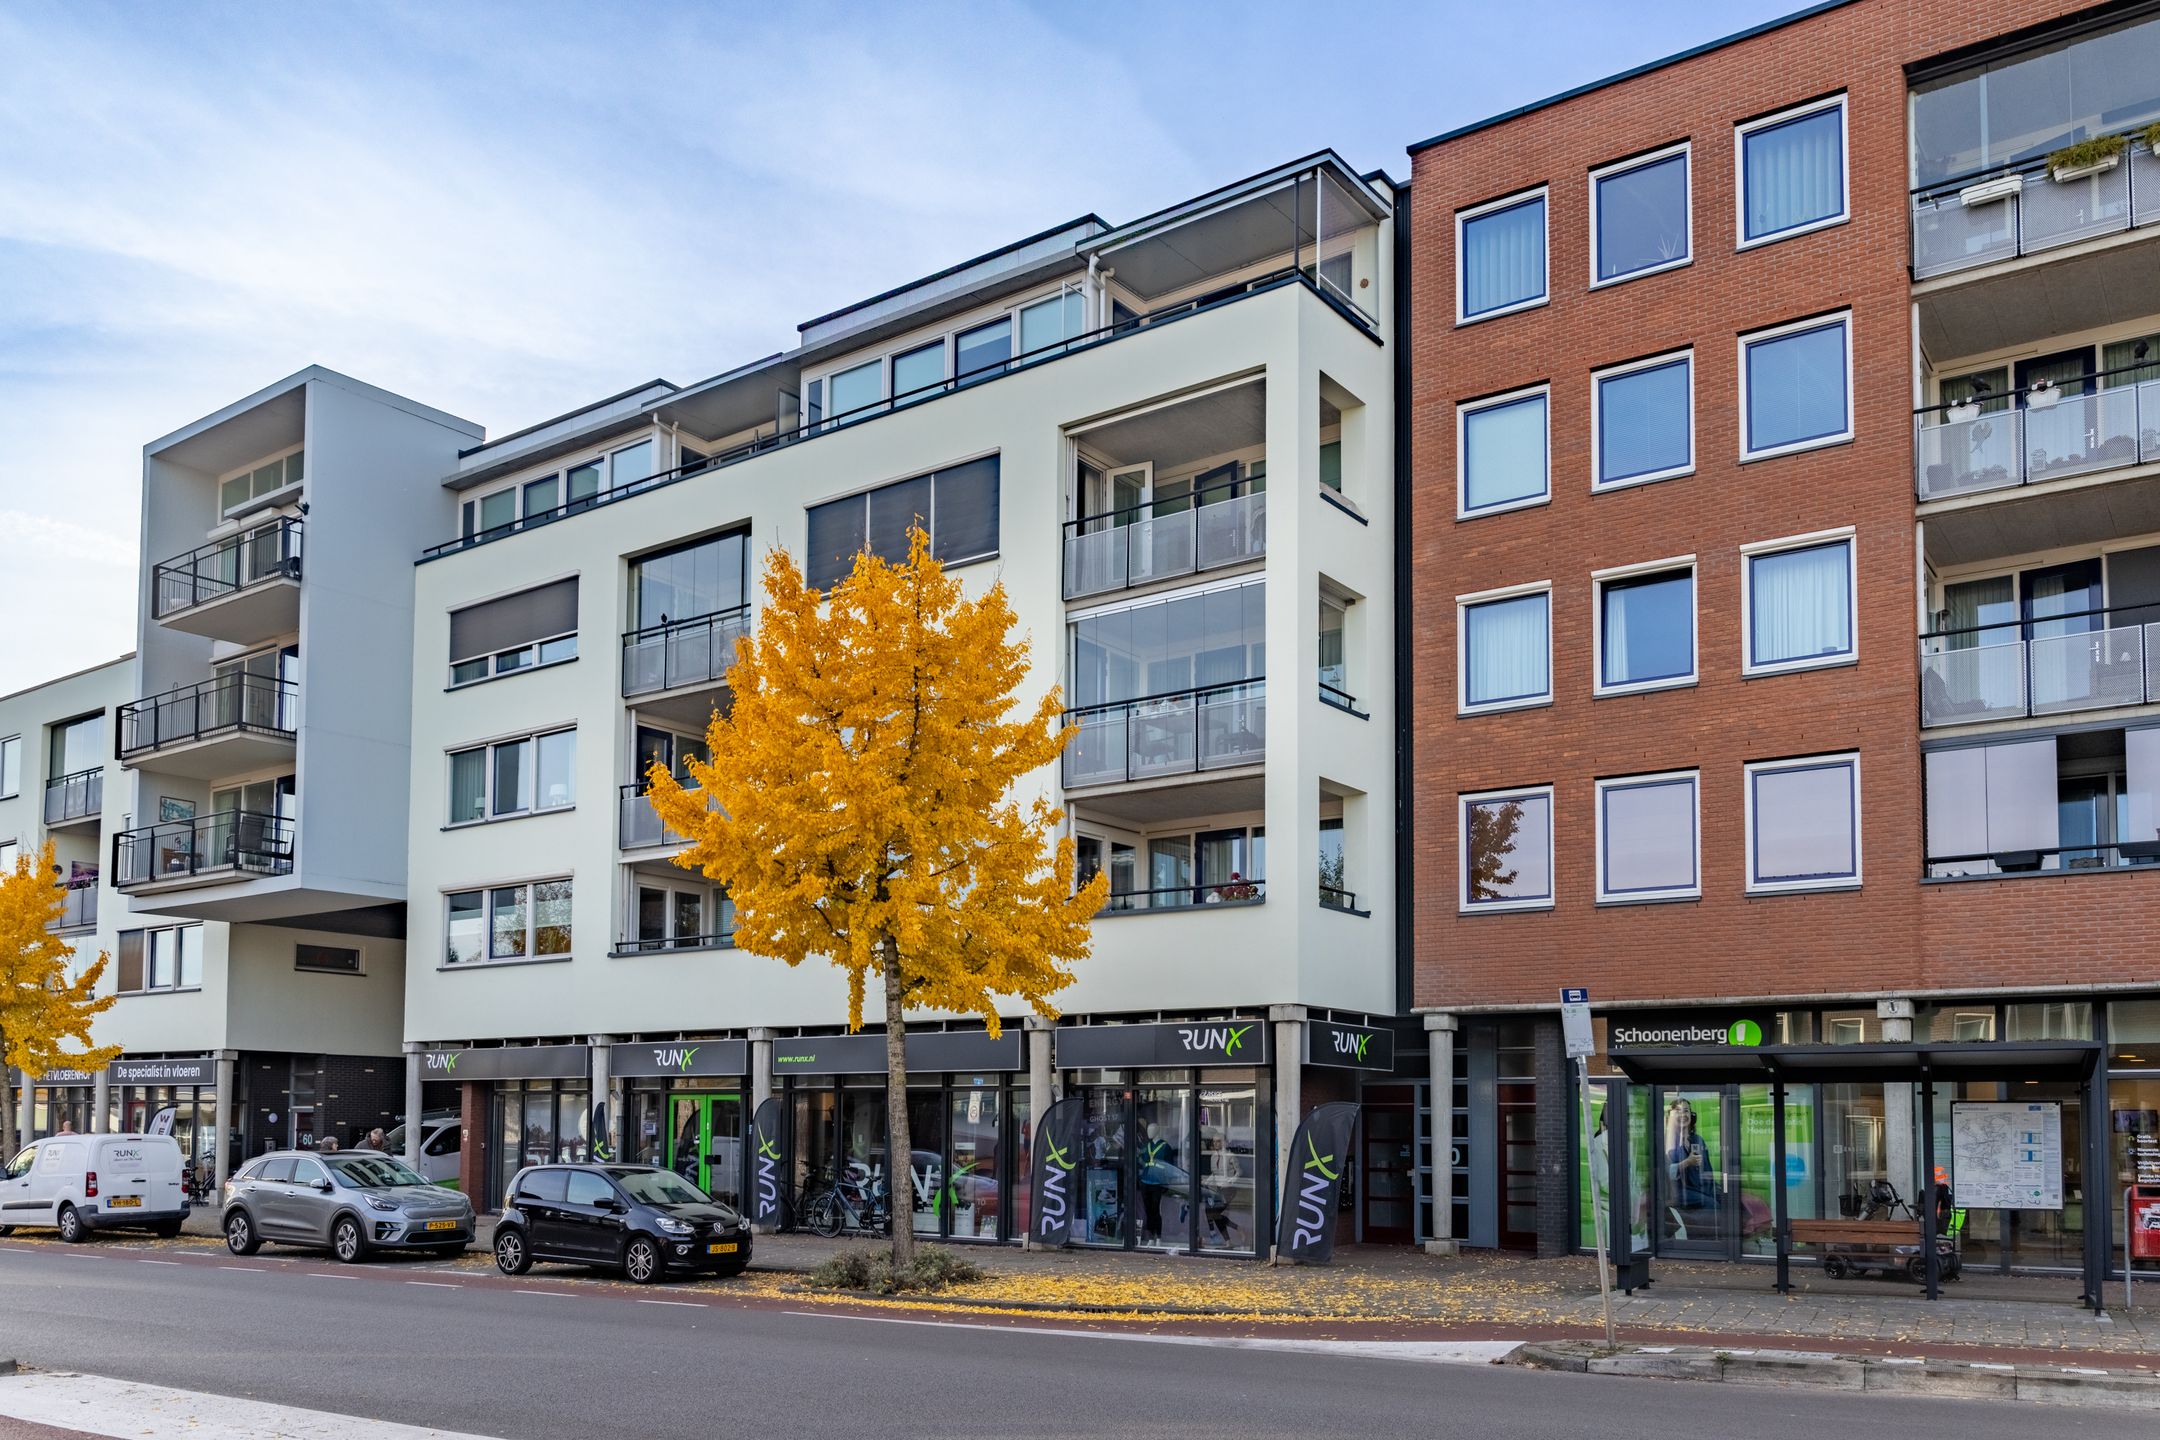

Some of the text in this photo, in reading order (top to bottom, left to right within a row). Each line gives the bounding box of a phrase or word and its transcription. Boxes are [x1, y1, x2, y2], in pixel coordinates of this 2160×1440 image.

[1178, 1024, 1255, 1056] RUNX
[1331, 1030, 1374, 1062] RUNX
[1615, 1026, 1727, 1044] Schoonenberg
[425, 1052, 462, 1073] RUNX
[654, 1047, 700, 1072] RUNX
[777, 1054, 816, 1063] www.runx.nl
[117, 1064, 200, 1081] De specialist in vloeren
[302, 1133, 313, 1145] 60
[113, 1148, 143, 1159] RUNX
[758, 1121, 781, 1218] RUNX
[1041, 1124, 1077, 1236] RUNX
[1292, 1129, 1340, 1250] RUNX
